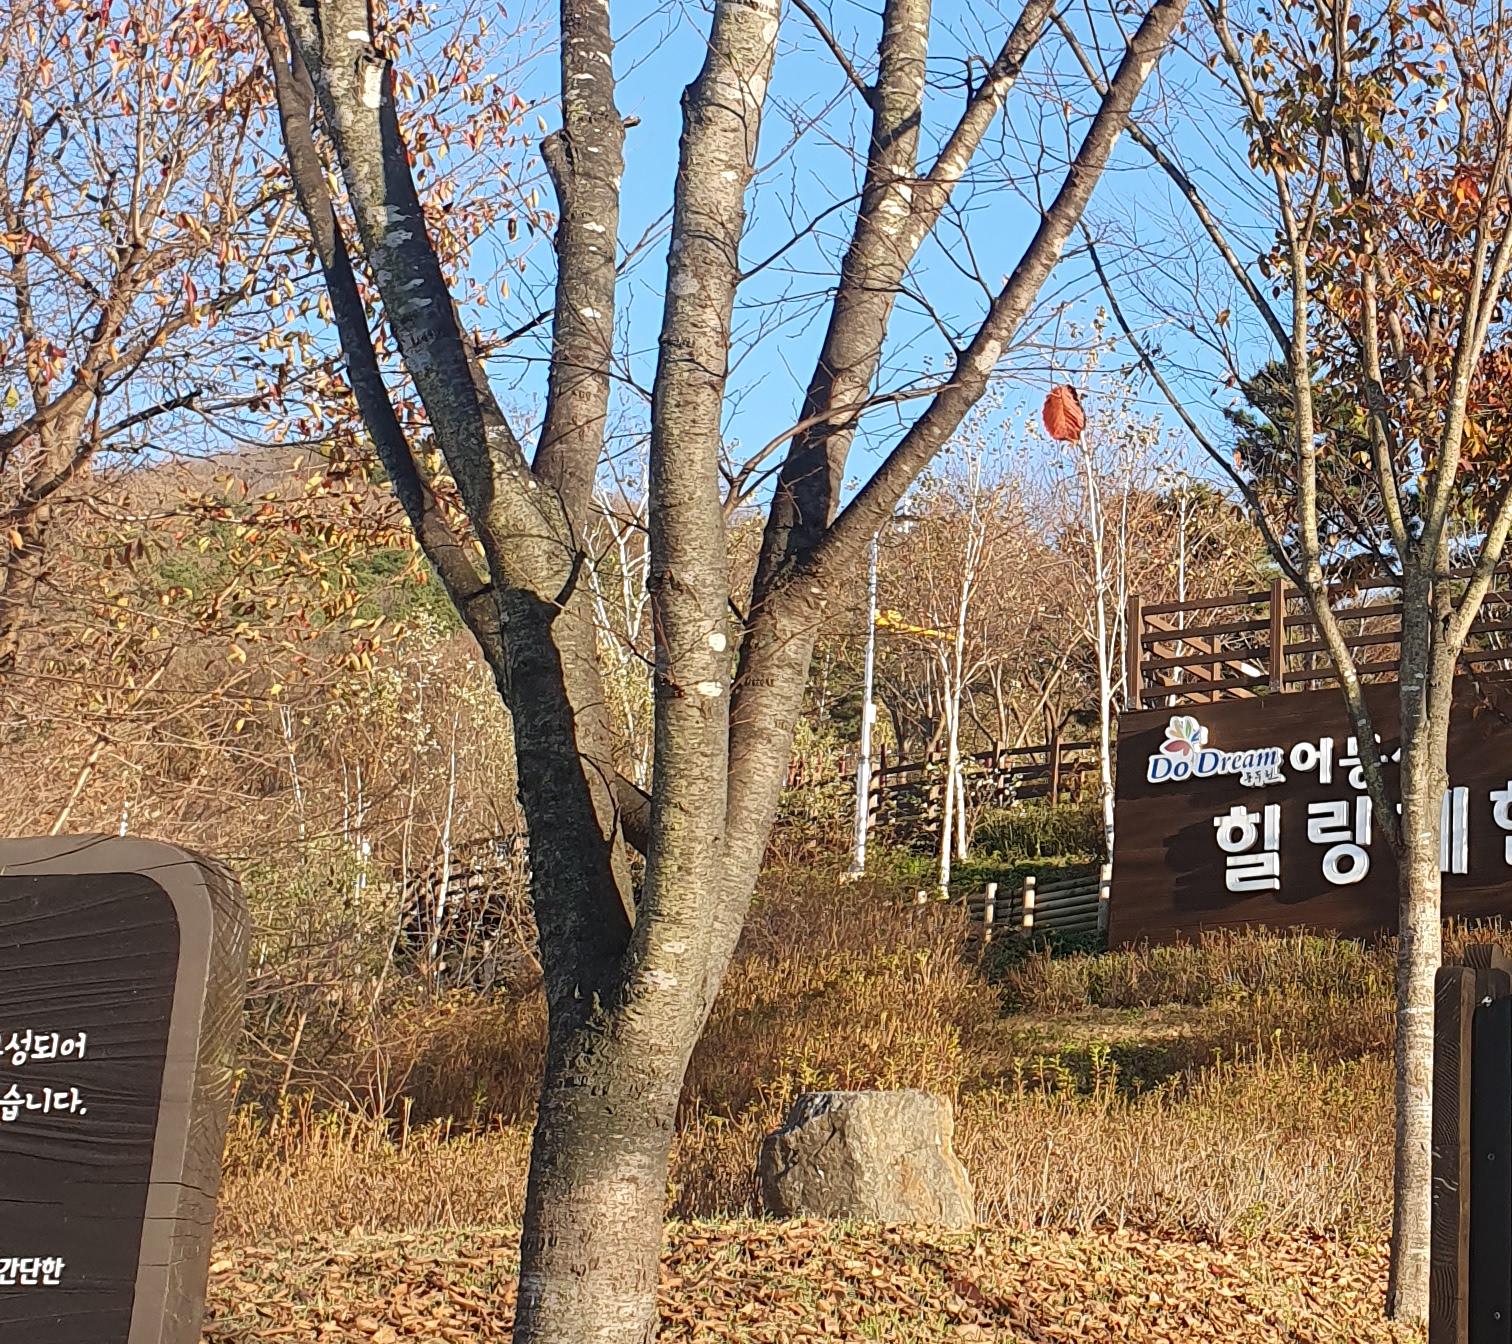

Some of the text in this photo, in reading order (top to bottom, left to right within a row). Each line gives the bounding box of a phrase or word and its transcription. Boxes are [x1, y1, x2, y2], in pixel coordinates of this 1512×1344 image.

[1151, 747, 1277, 779] Do Dream
[0, 1029, 87, 1066] 성되어
[0, 1257, 65, 1285] 간단한
